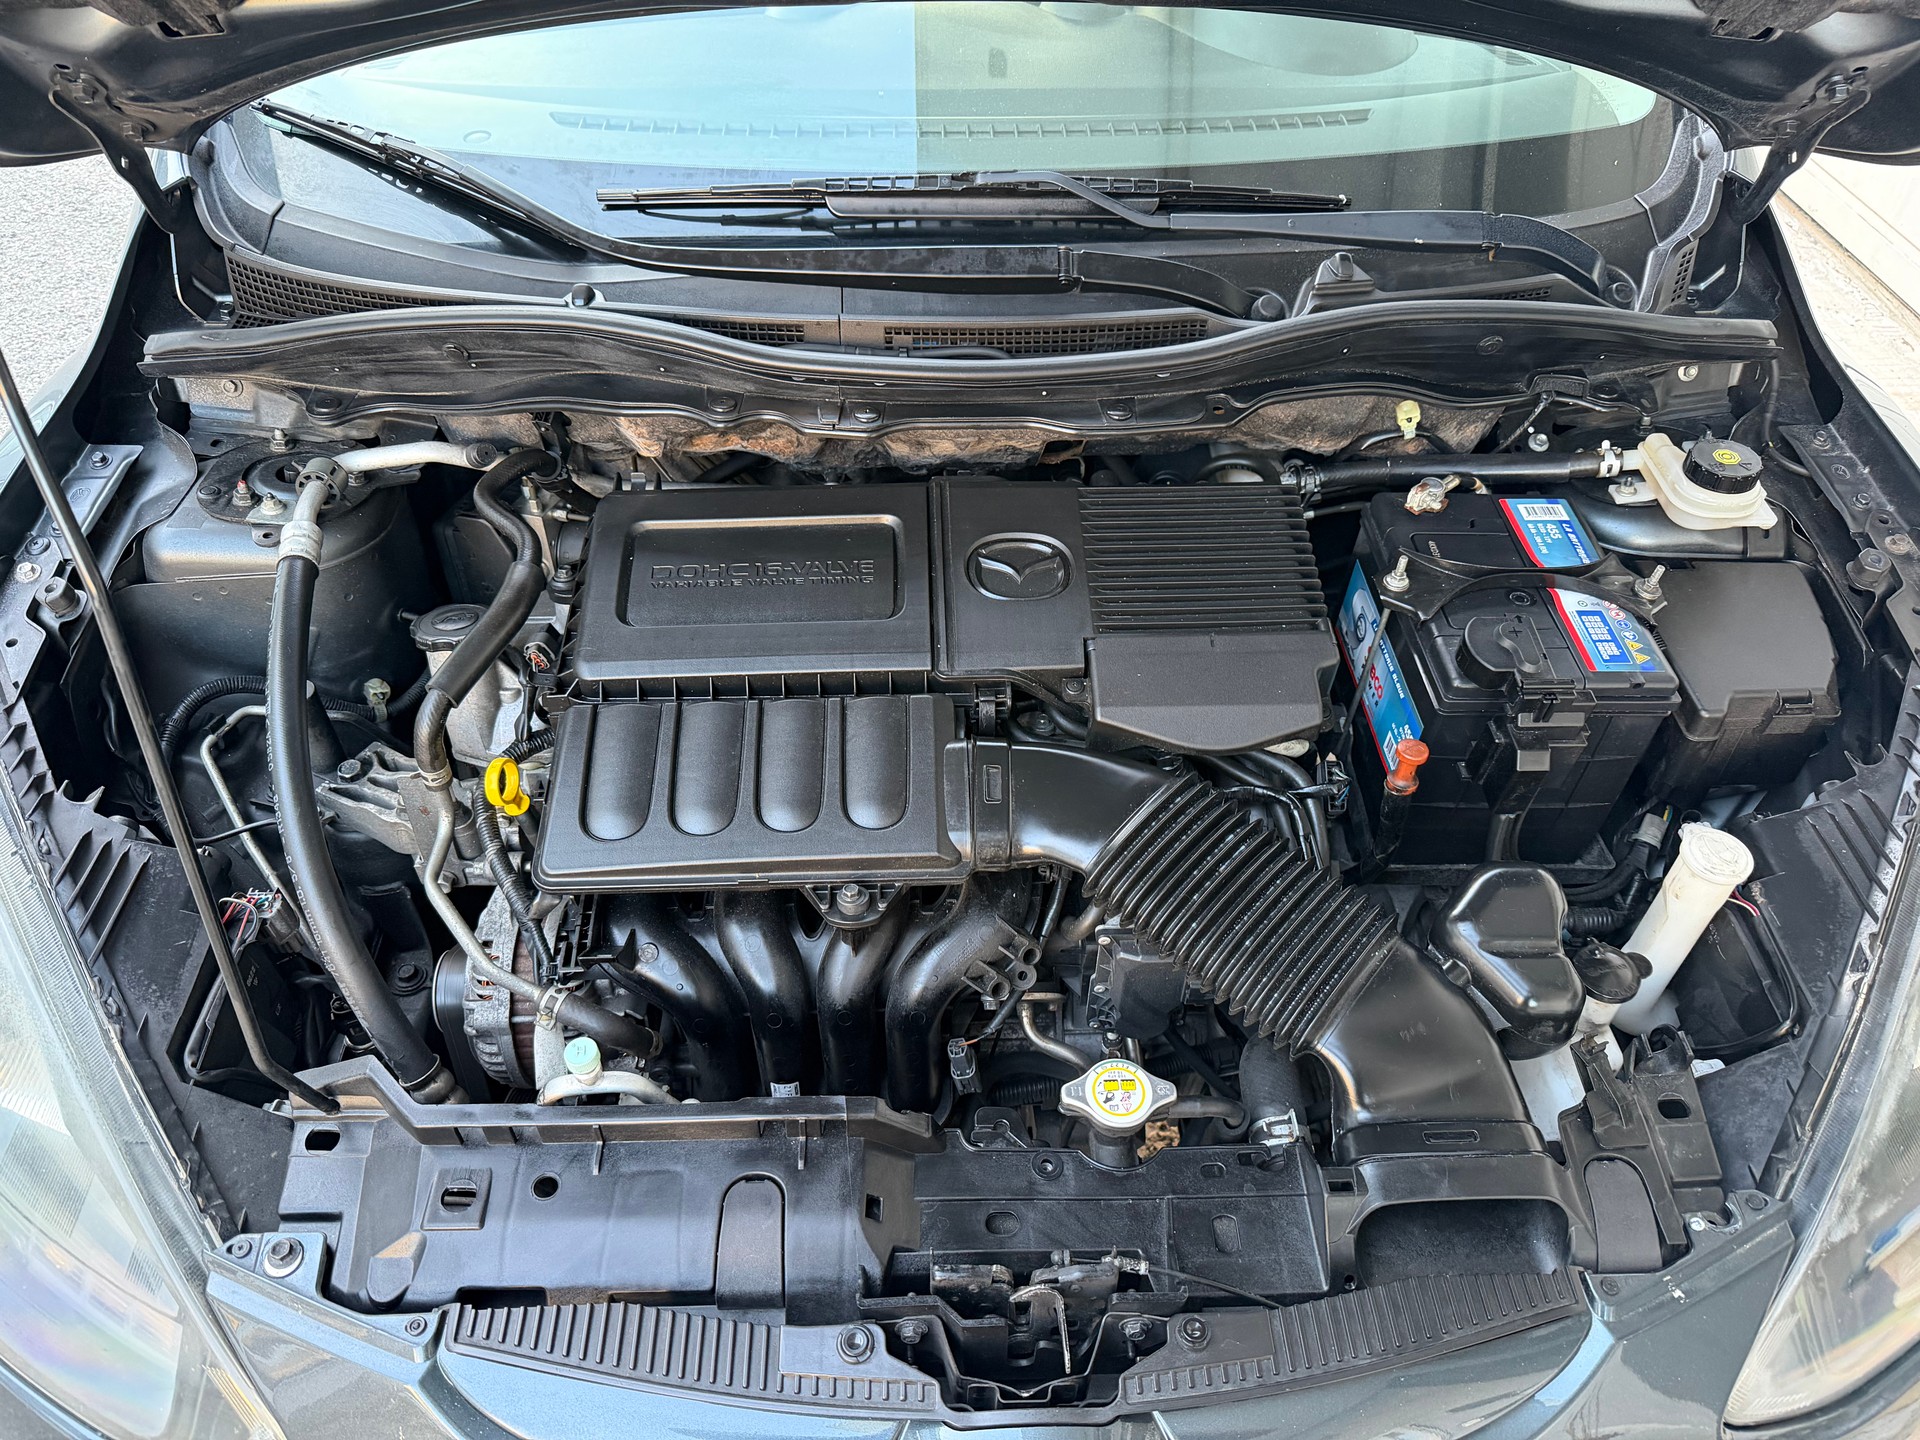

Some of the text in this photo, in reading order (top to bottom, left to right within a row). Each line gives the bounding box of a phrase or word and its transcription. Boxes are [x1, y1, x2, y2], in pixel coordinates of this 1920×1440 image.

[1546, 523, 1562, 539] 455
[651, 560, 874, 579] DOHC 16-VALVE
[650, 575, 874, 589] VARIABLE VALVE TIMING
[1379, 639, 1395, 672] ATTERIE
[1392, 673, 1405, 699] BLEUE
